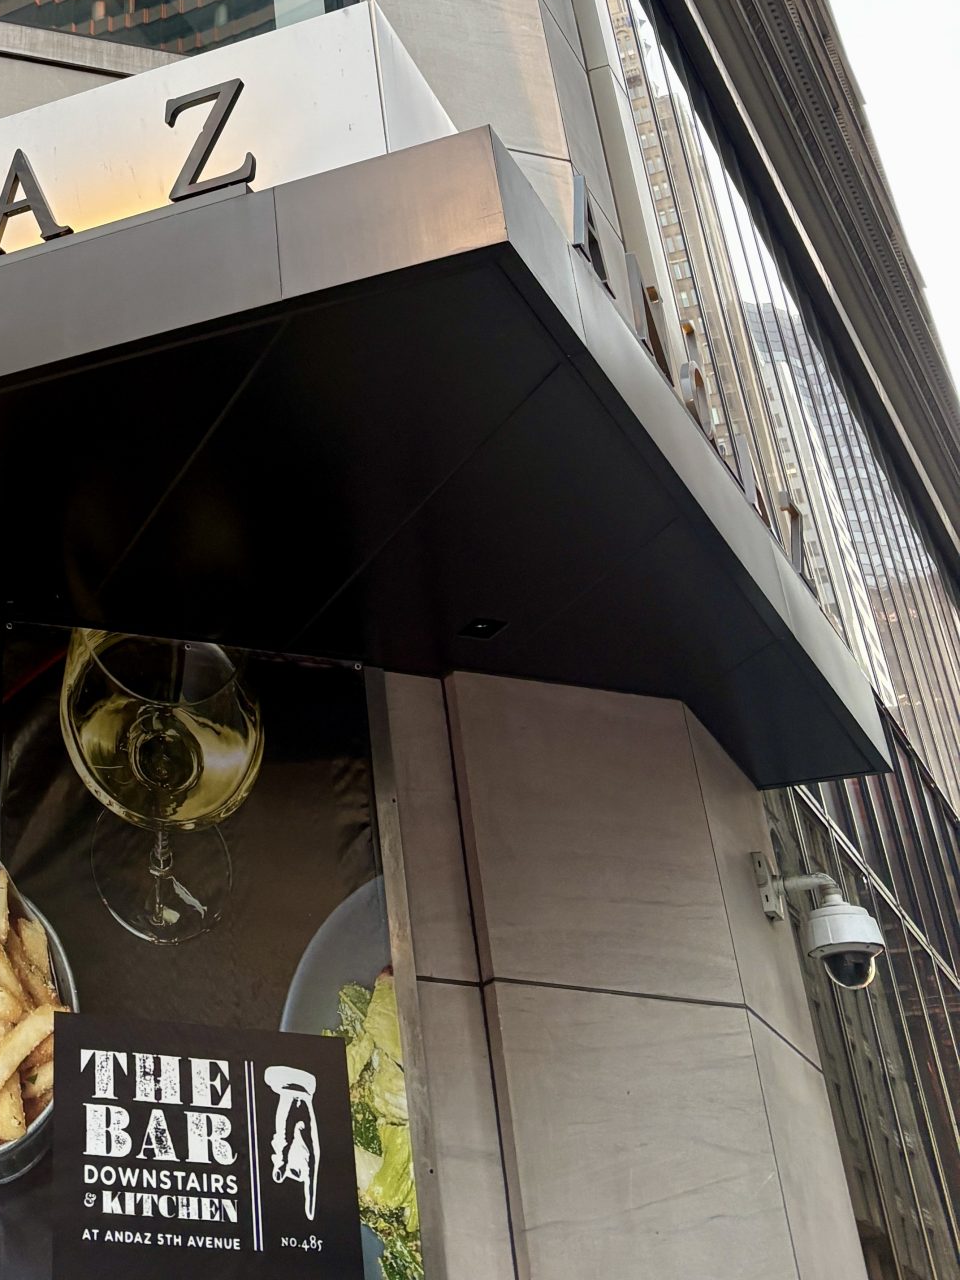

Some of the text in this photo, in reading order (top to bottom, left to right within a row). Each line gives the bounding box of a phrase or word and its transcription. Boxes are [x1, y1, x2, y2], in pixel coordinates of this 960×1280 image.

[80, 1048, 232, 1109] THE
[82, 1103, 238, 1166] BAR
[83, 1164, 238, 1195] DOWNSTAIRS
[83, 1190, 238, 1223] & KITCHEN
[82, 1228, 241, 1251] AT ANDAZ 5TH AVENUE
